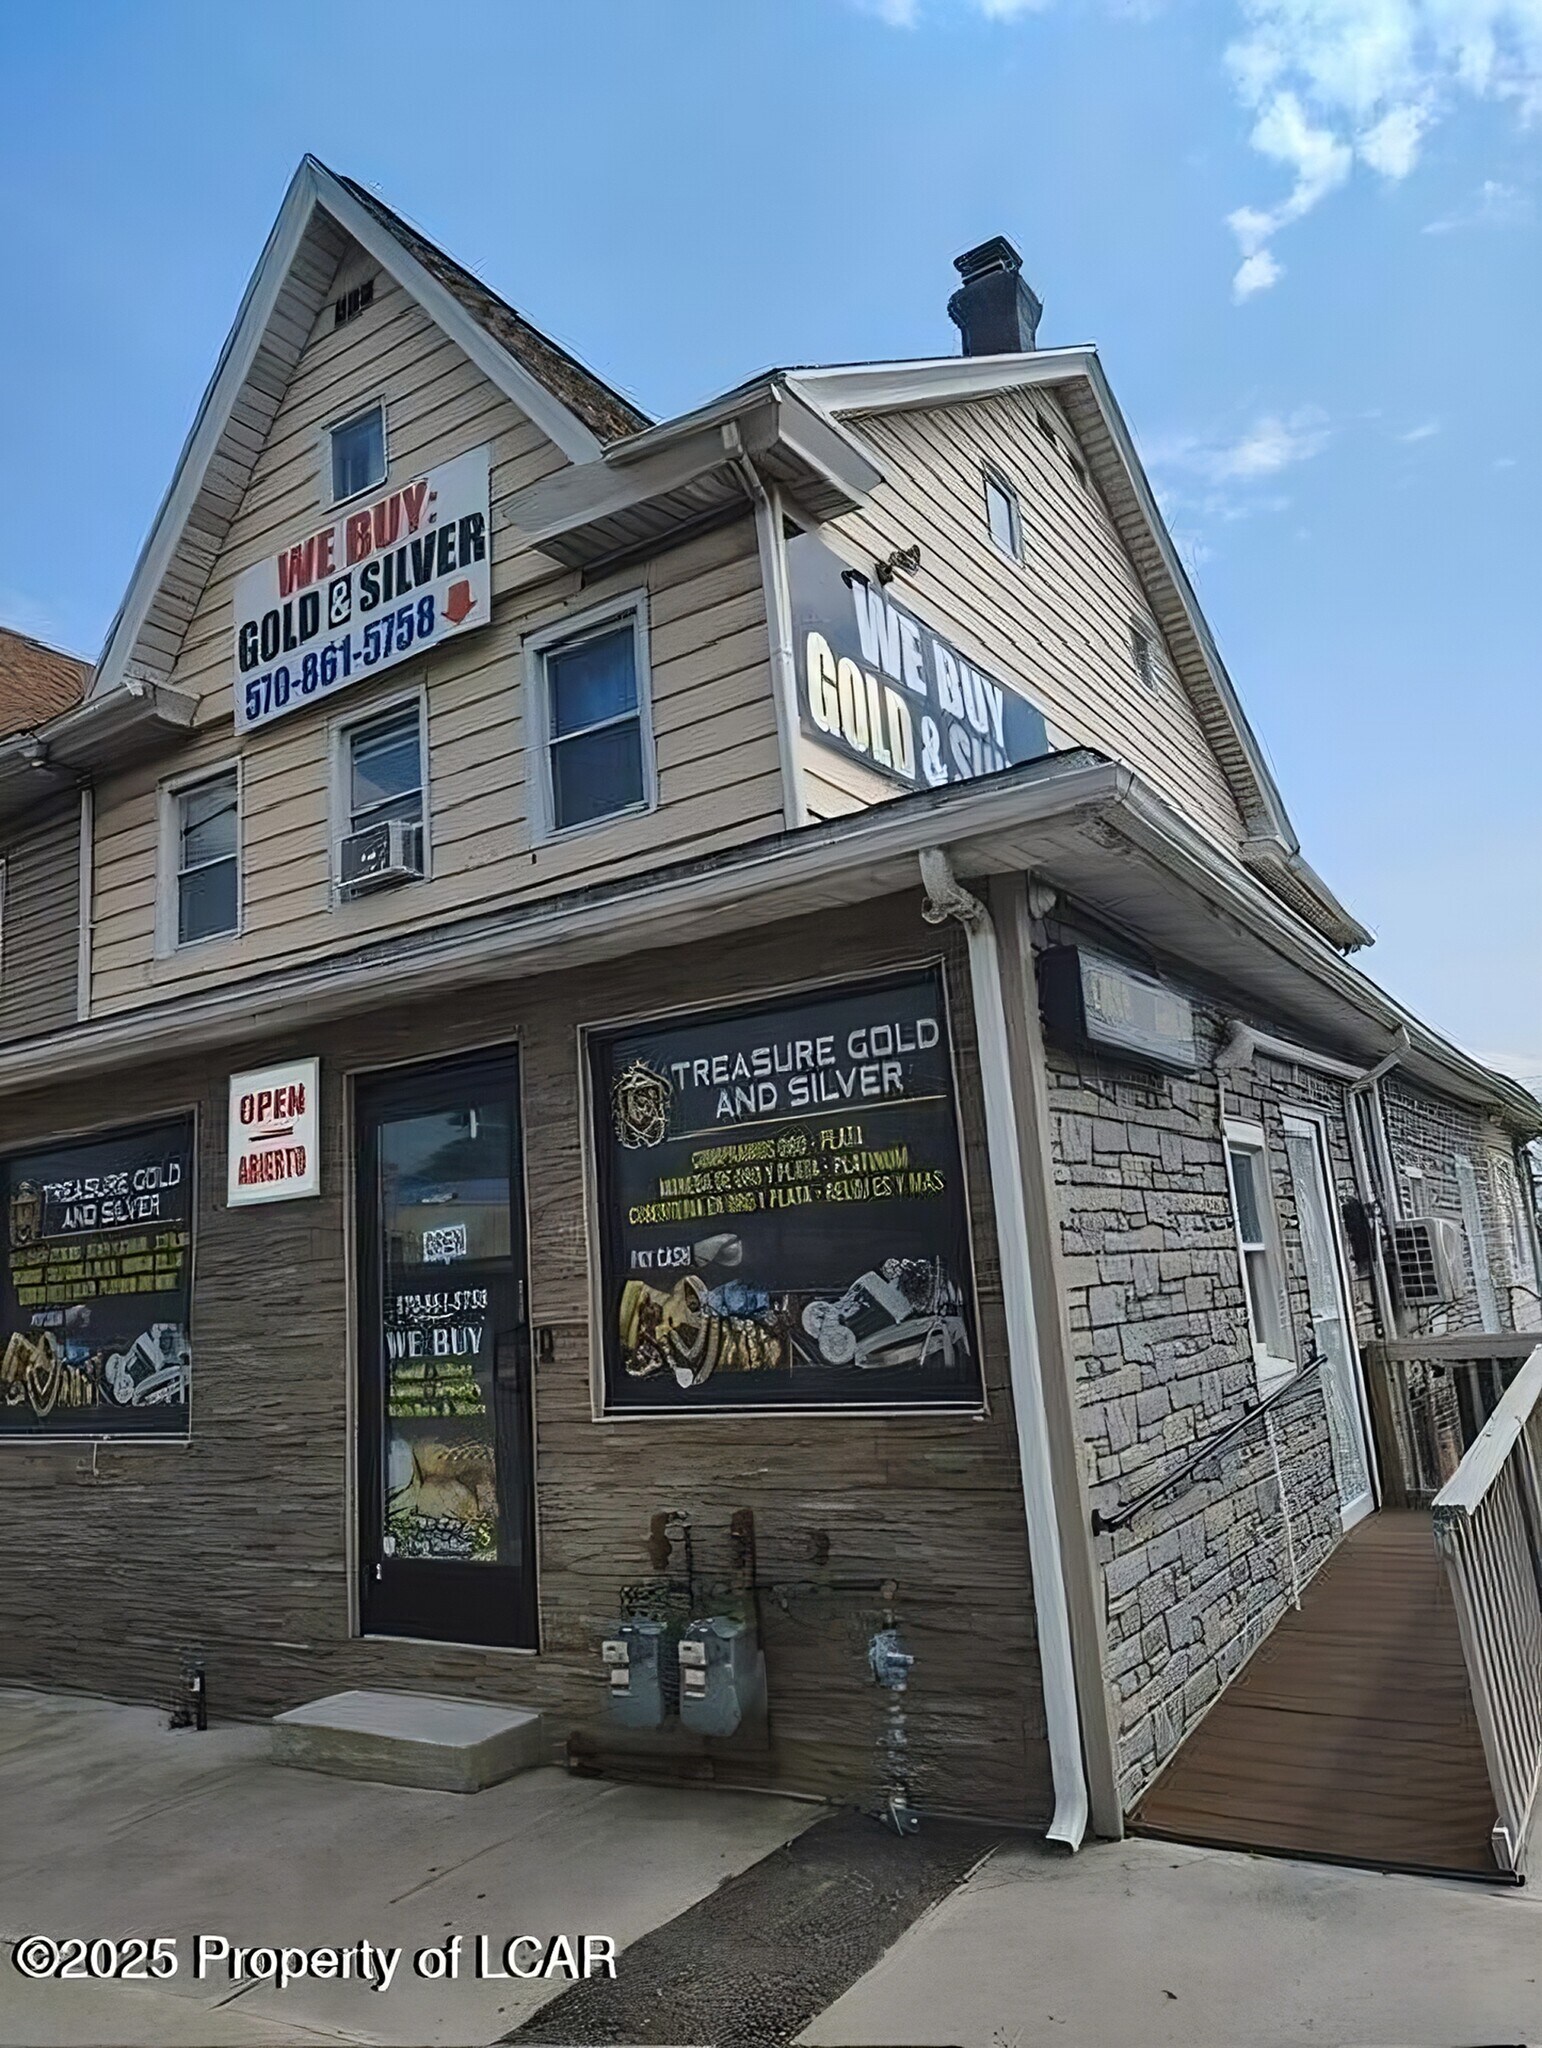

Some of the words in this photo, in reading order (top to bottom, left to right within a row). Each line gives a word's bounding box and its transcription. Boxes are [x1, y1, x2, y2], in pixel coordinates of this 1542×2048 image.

[239, 590, 320, 673] GOLD
[328, 572, 352, 631] &
[360, 511, 486, 612] SILVER
[277, 527, 336, 598] WE
[245, 594, 436, 721] 570-861-5758
[852, 578, 927, 696] WE
[932, 639, 1004, 748] BUY
[807, 631, 916, 780] GOLD
[921, 715, 949, 787] &
[671, 1035, 836, 1090] TREASURE
[847, 1018, 939, 1060] GOLD
[240, 1082, 306, 1125] OPEN
[716, 1082, 777, 1120] AND
[789, 1060, 904, 1107] SILVER
[133, 1163, 181, 1191] GOLD
[386, 1331, 424, 1359] WE
[433, 1327, 482, 1356] BUY
